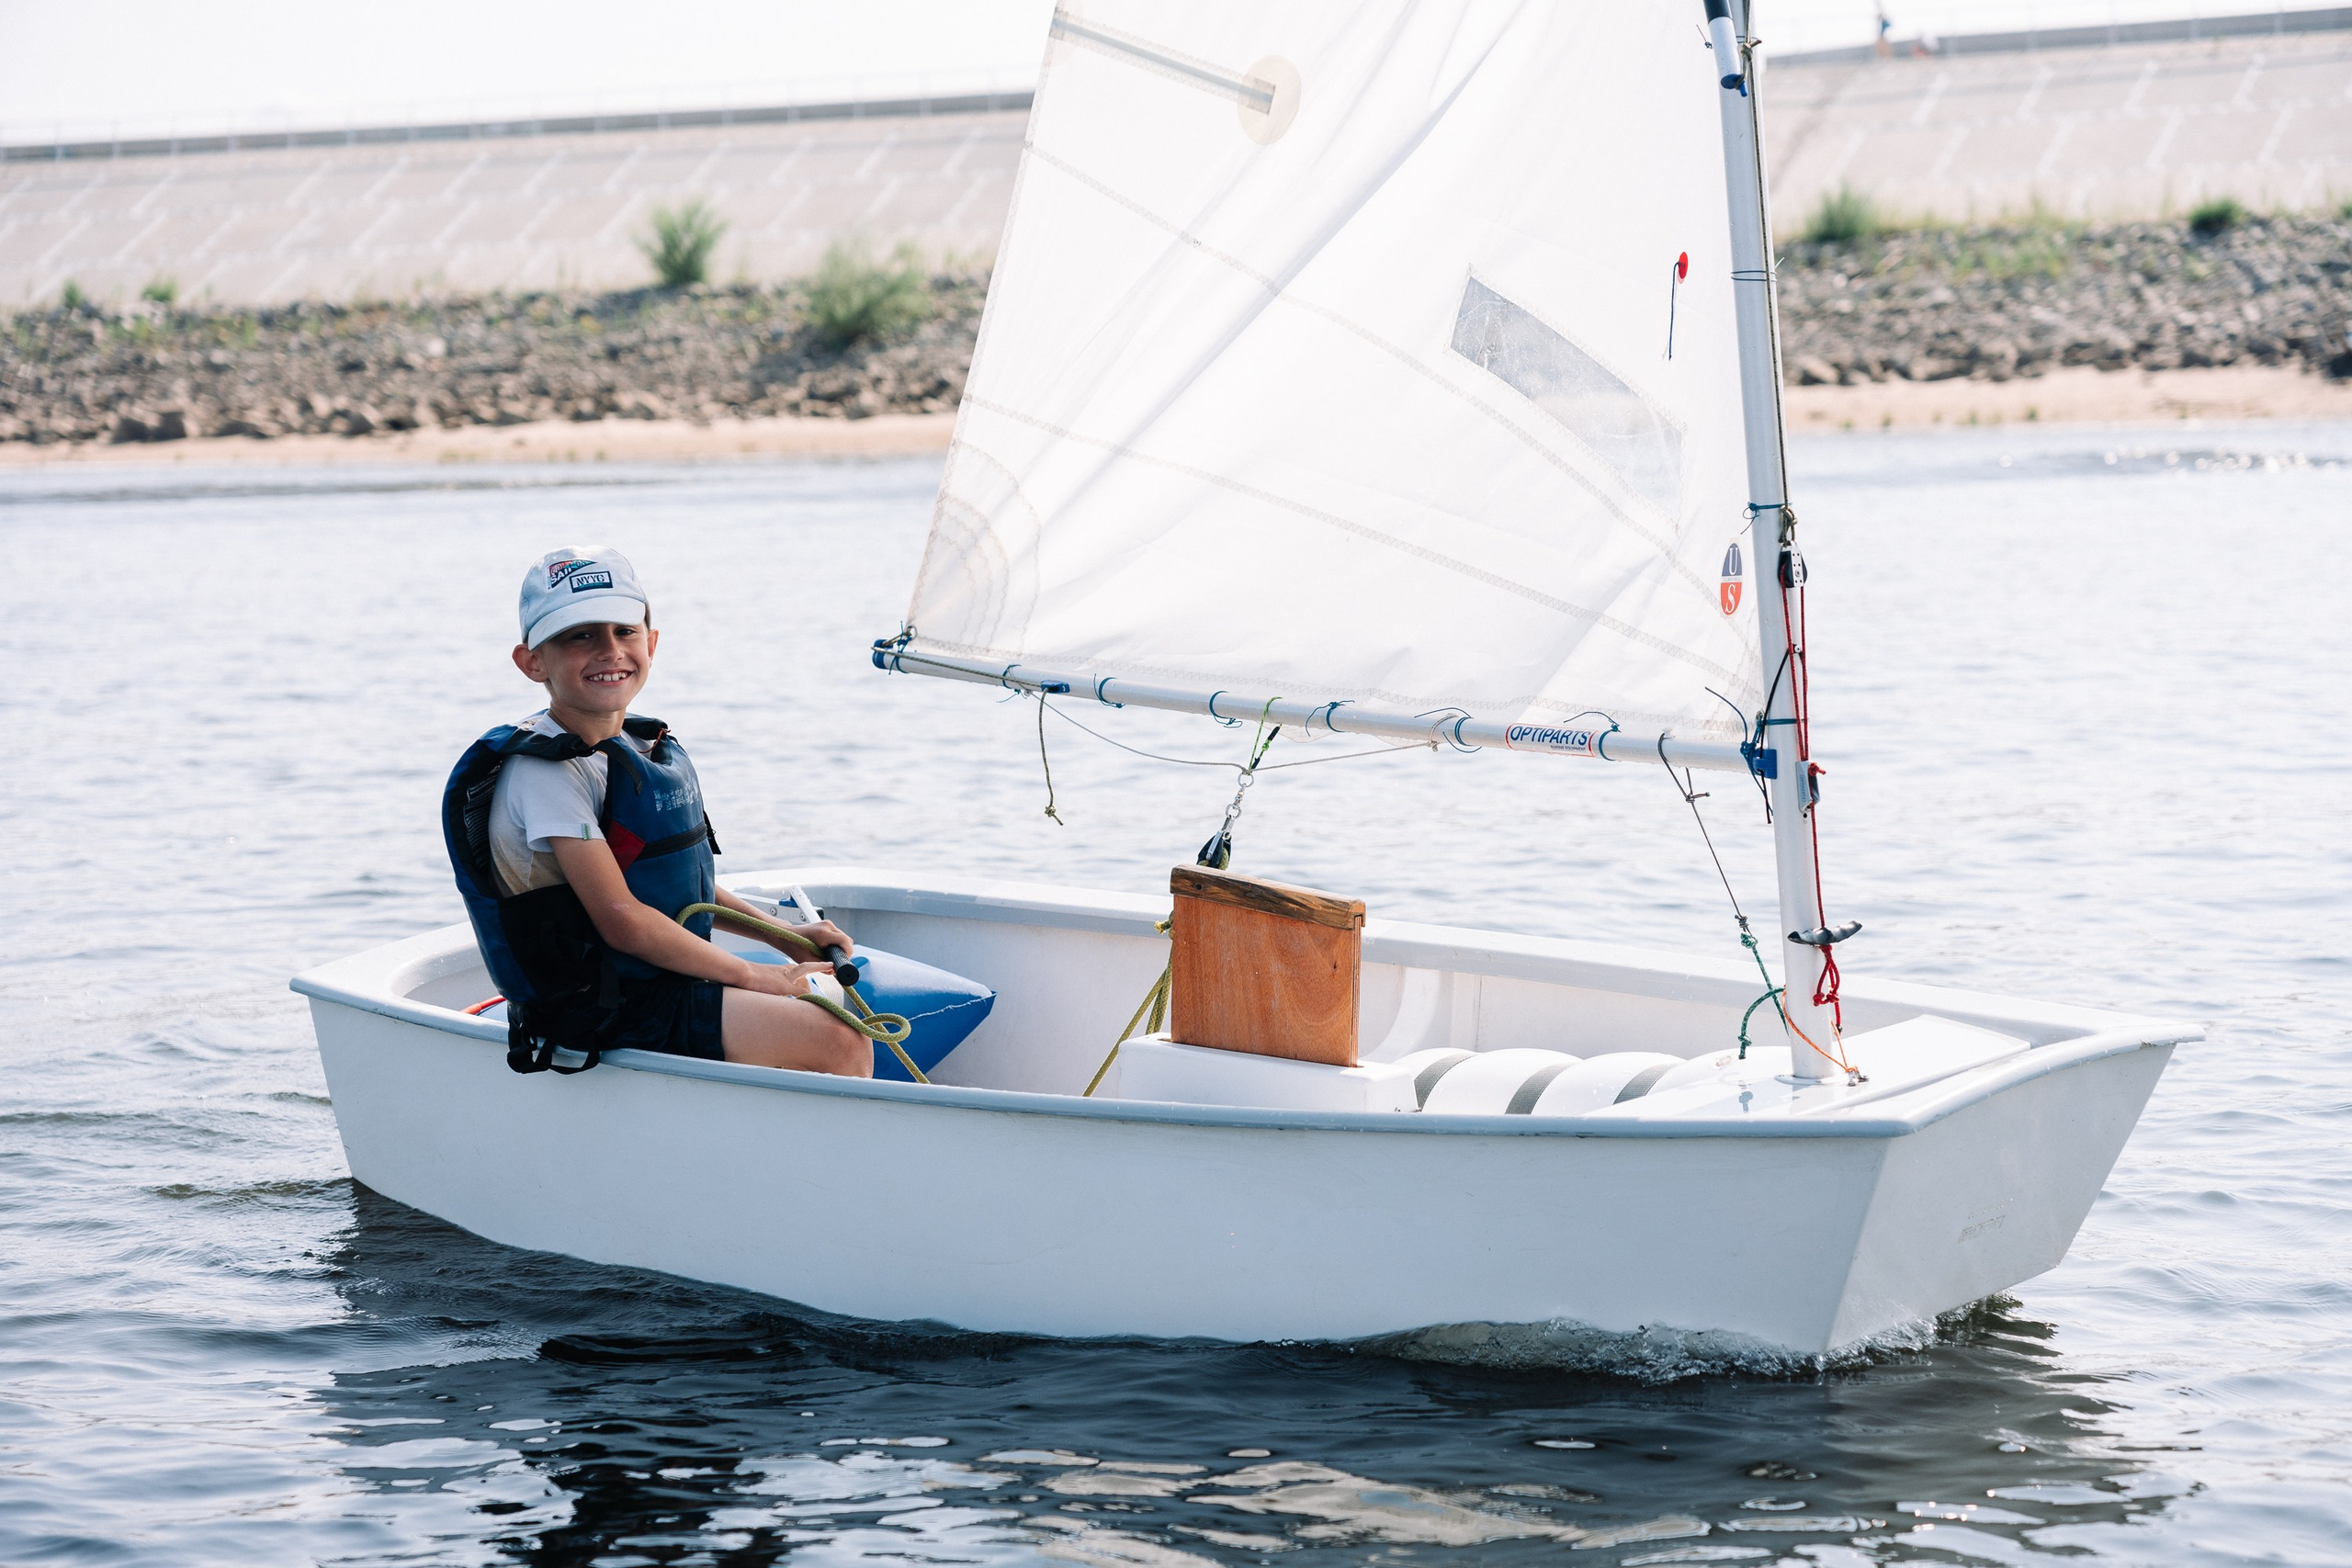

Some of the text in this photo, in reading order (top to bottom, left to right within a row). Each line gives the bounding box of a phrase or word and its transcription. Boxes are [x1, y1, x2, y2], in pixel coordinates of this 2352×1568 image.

[1729, 547, 1738, 575] U
[1724, 583, 1736, 614] S
[1510, 726, 1591, 746] OPTIPARTS
